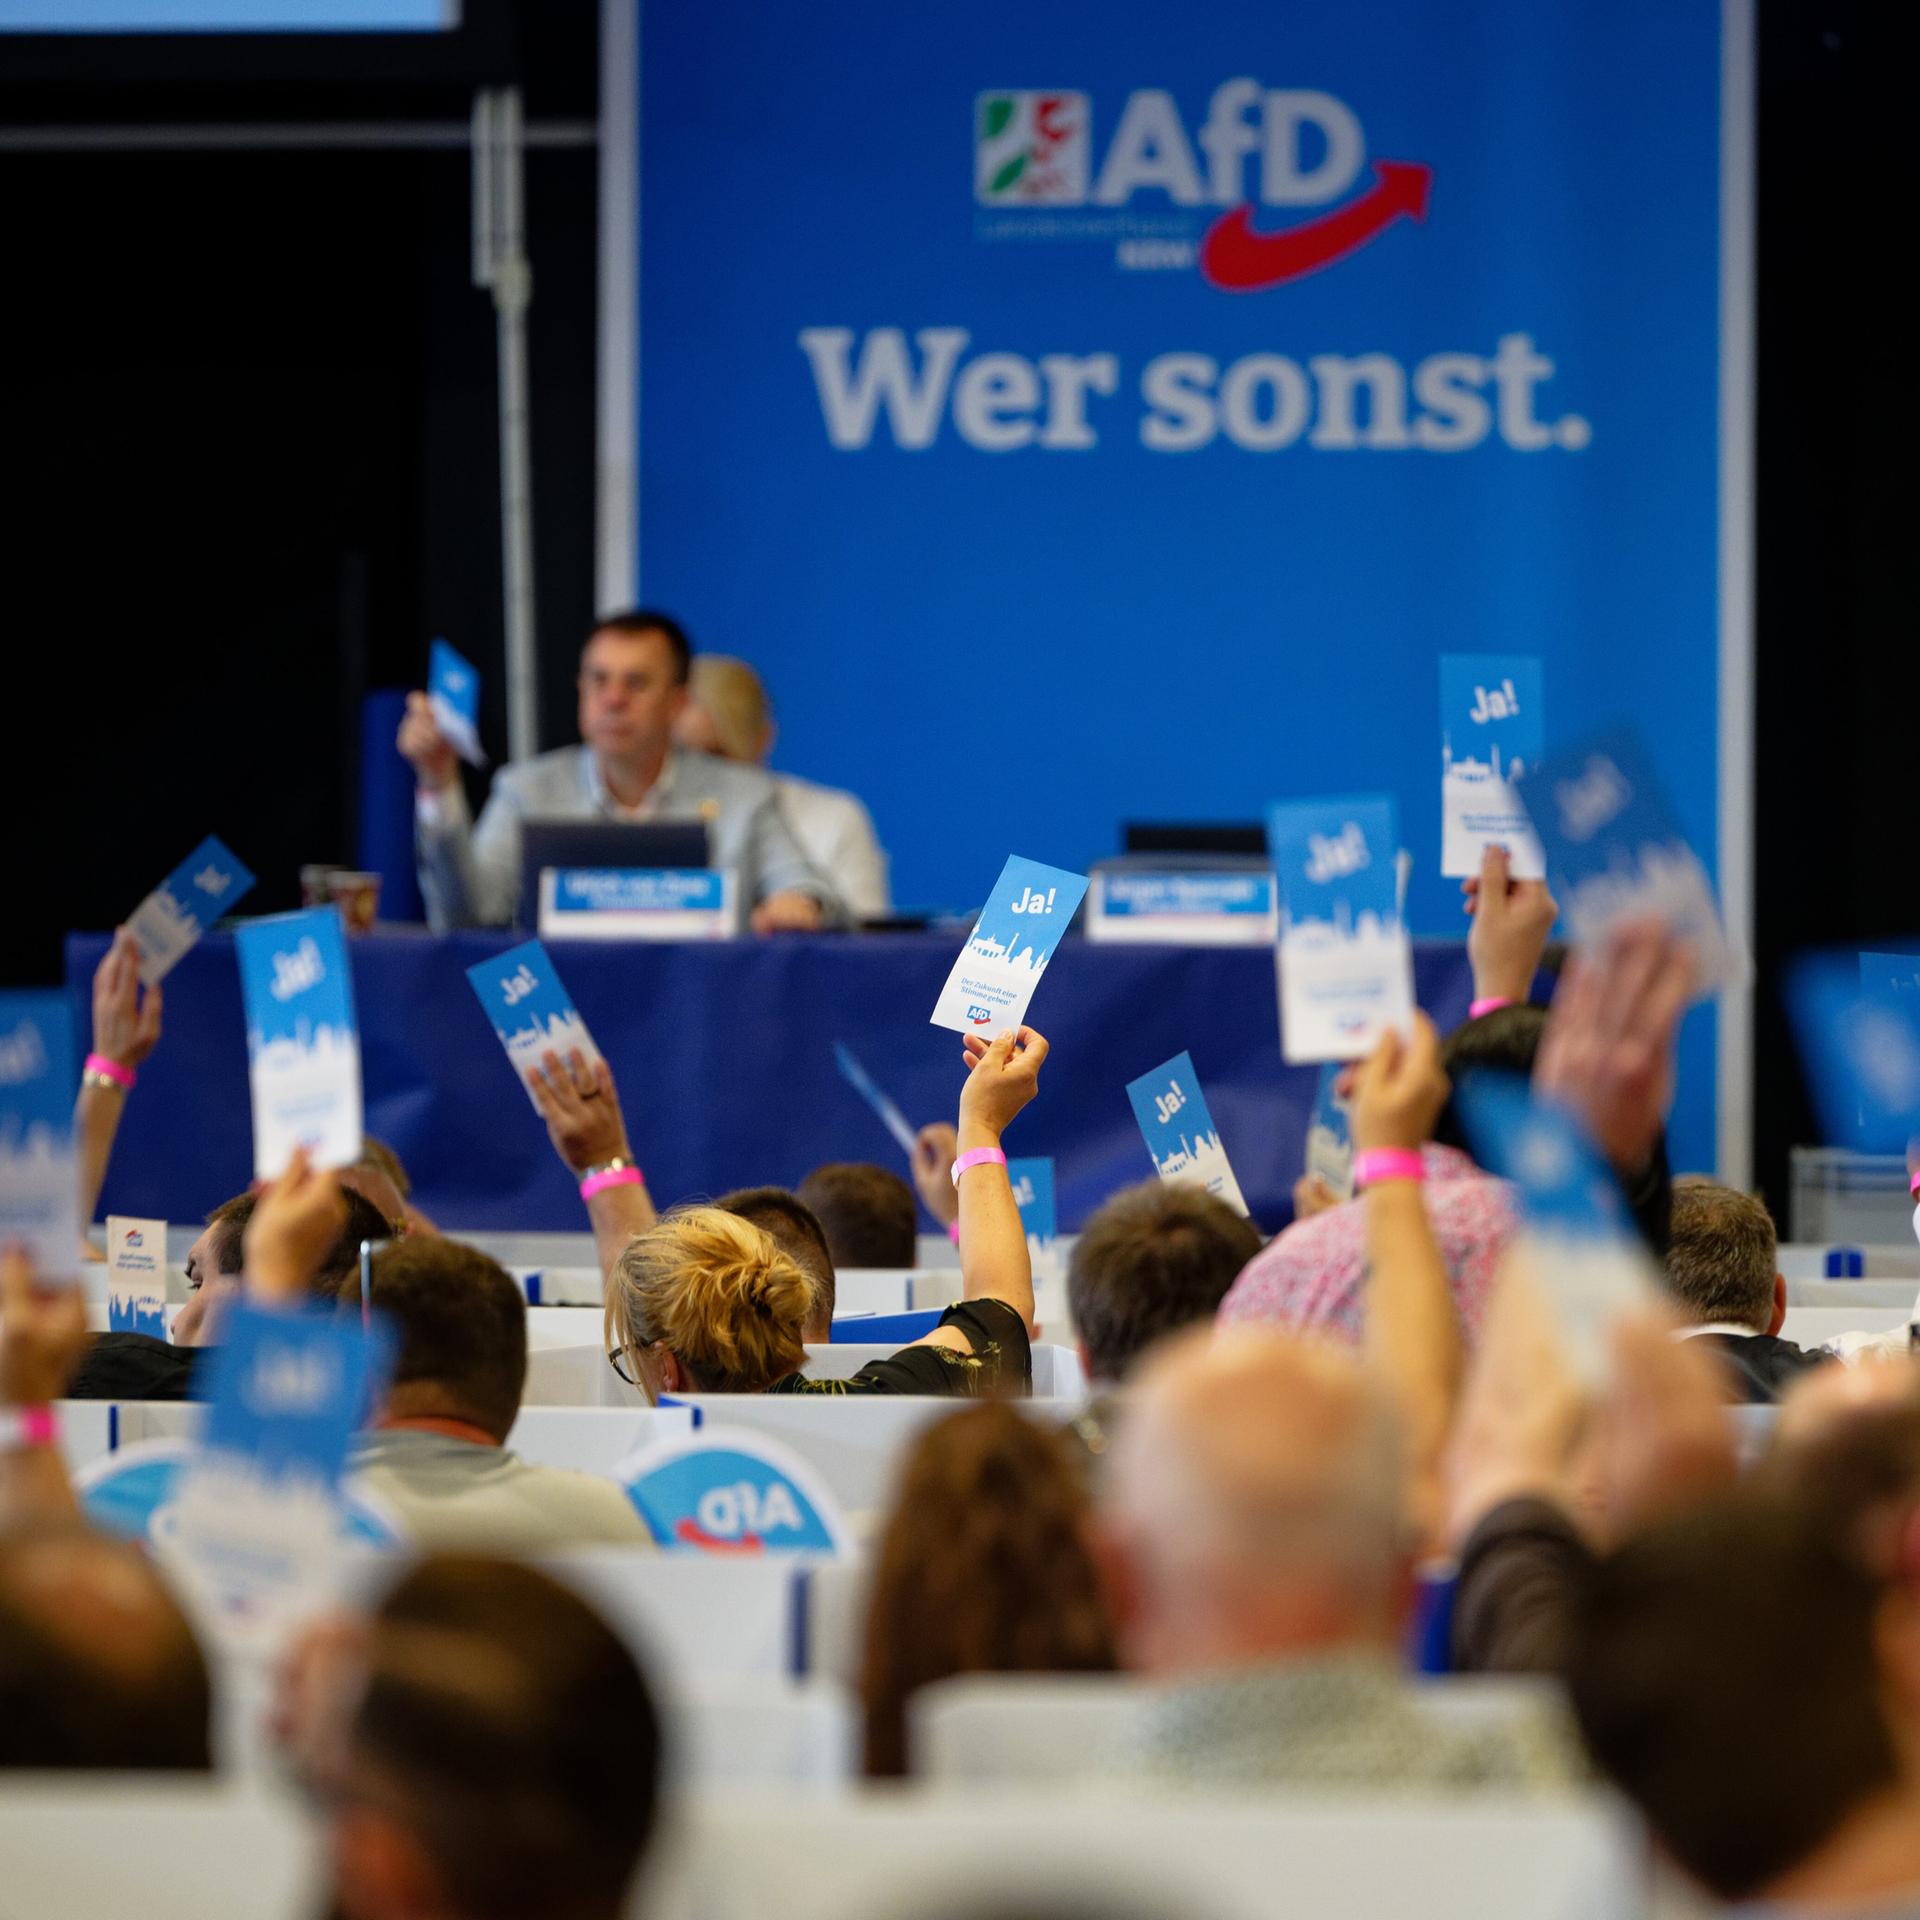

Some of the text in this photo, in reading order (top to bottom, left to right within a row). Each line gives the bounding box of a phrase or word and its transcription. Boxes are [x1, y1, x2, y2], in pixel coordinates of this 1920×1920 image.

[1096, 78, 1366, 207] AfD
[801, 327, 1591, 453] Wer sonst.
[1469, 679, 1519, 725] Ja!
[1011, 887, 1057, 914] Ja!
[501, 964, 539, 1006] Ja!
[960, 986, 988, 998] Stimme
[961, 977, 1018, 999] Der Zukunft eine
[968, 1007, 988, 1020] AfD
[1155, 1080, 1187, 1124] Ja!
